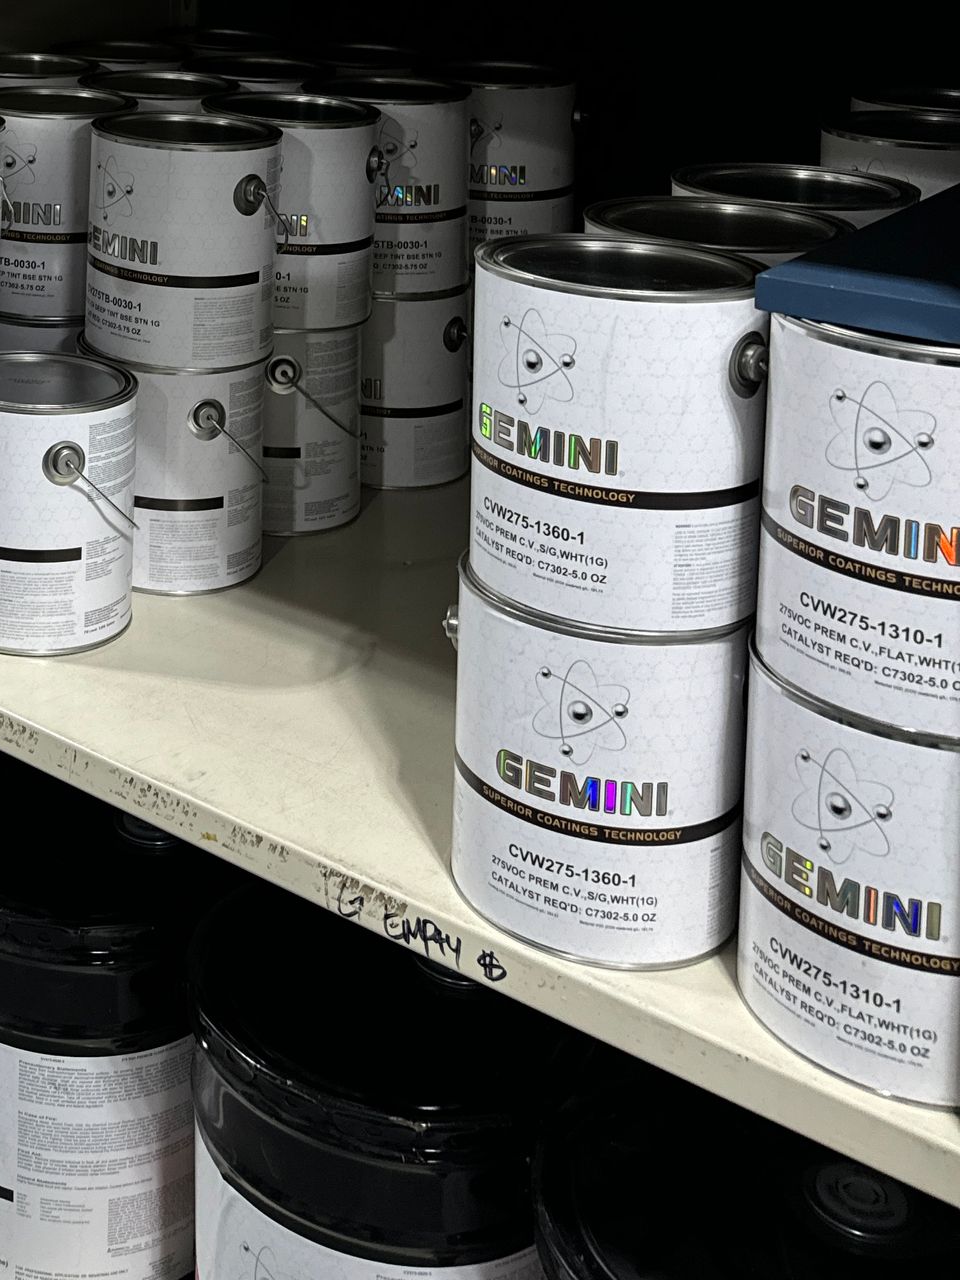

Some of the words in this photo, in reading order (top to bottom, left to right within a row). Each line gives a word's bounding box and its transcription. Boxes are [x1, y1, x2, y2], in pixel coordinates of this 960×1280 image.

[24, 234, 70, 242] TECHNOLOGY
[120, 268, 168, 284] TECHNOLOGY
[479, 402, 619, 476] GEMINI
[501, 463, 549, 488] COATINGS
[553, 480, 636, 503] TECHNOLOGY
[484, 496, 586, 545] CVW275-1360-1
[495, 525, 517, 545] PREM
[537, 559, 587, 582] C7302-5.0
[590, 573, 607, 584] OZ
[777, 528, 824, 560] SUPERIOR
[829, 555, 897, 583] COATINGS
[779, 603, 811, 630] 275VOC
[814, 621, 846, 644] PREM
[799, 591, 944, 649] CVW275-1310-1
[781, 623, 832, 658] CATALYST
[835, 649, 877, 675] REQ'D:
[881, 664, 949, 690] C7302-5.0
[496, 748, 669, 817] GEMINI
[483, 785, 533, 818] SUPERIOR
[537, 813, 598, 837] COATINGS
[604, 829, 682, 842] TECHNOLOGY
[491, 855, 526, 881] 275VOC
[528, 873, 559, 893] PREM
[508, 843, 637, 888] CVW275-1360-1
[760, 831, 942, 942] GEMINI
[491, 871, 542, 906] CATALYST
[543, 896, 582, 915] REQ'D:
[585, 907, 638, 922] C7302-5.0
[641, 912, 657, 922] OZ
[749, 871, 792, 914] SUPERIOR
[795, 906, 858, 947] COATINGS
[863, 939, 960, 972] TECHNOLOGY
[770, 936, 902, 1014] CVW275-1310-1
[782, 969, 812, 998] PREM
[753, 962, 797, 1007] CATALYST
[843, 1022, 908, 1055] C7302-5.0
[910, 1044, 931, 1060] OZ
